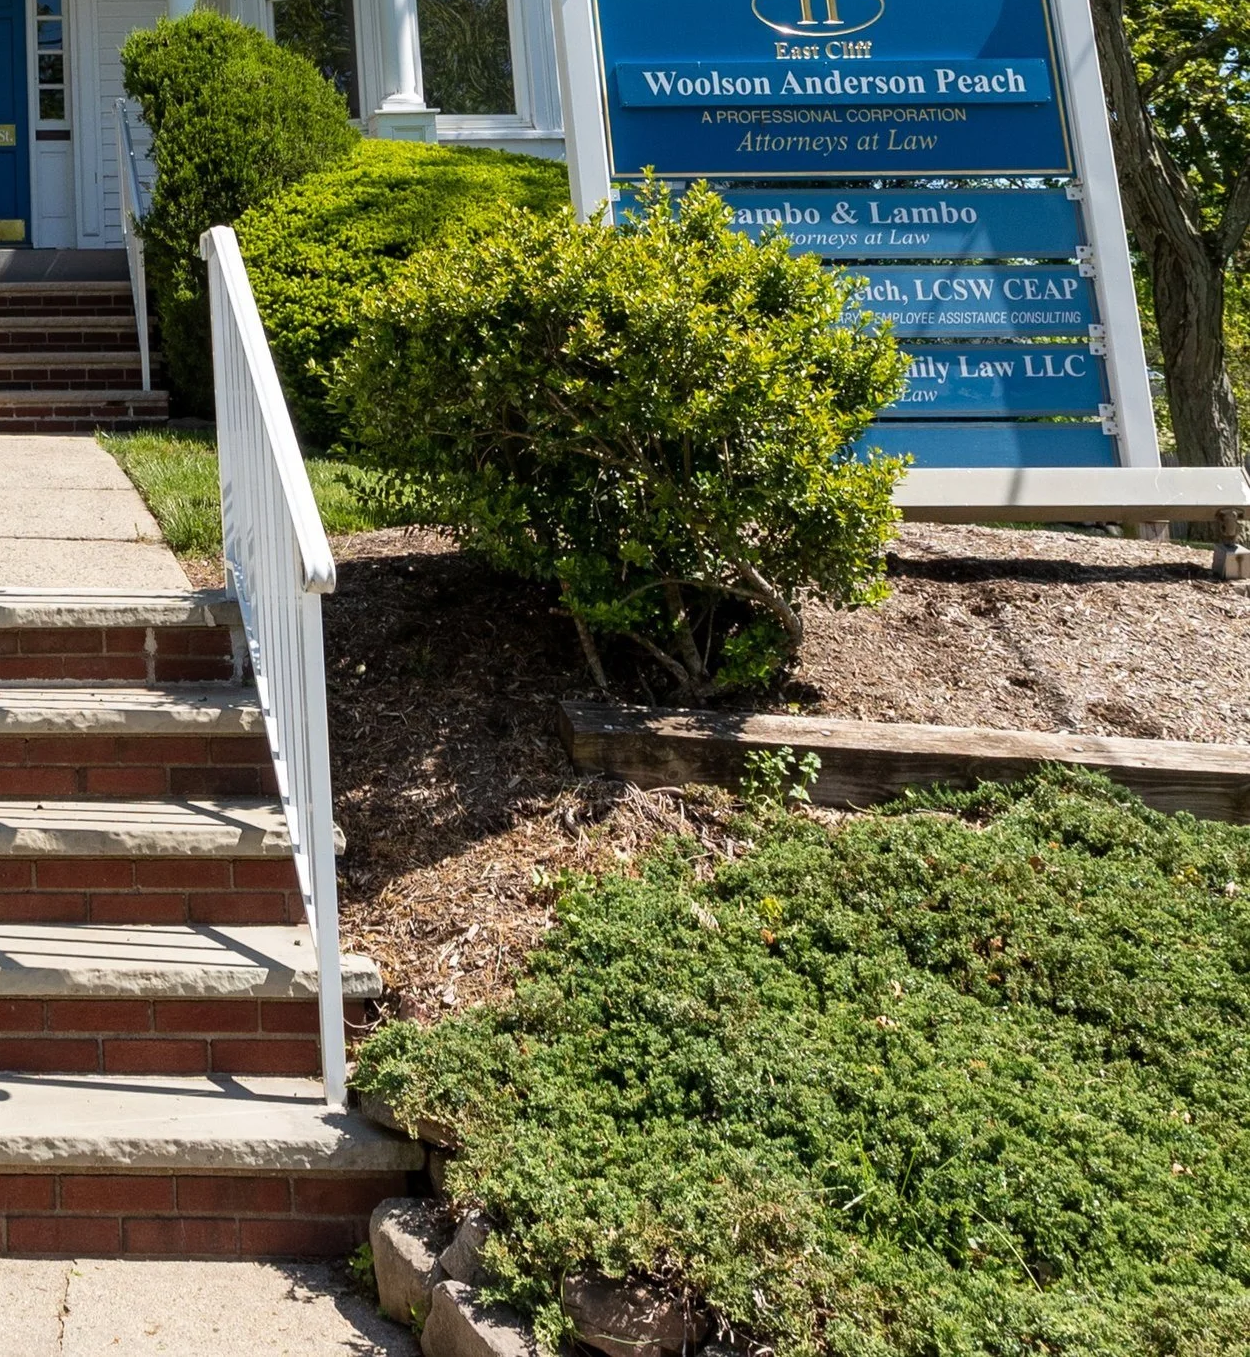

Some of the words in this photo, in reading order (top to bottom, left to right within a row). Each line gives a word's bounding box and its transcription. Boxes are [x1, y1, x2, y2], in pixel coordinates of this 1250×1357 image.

[774, 42, 820, 60] East
[825, 40, 873, 59] Cliff
[642, 70, 772, 96] Woolson
[779, 69, 926, 95] Anderson
[934, 68, 1027, 94] Peach
[701, 111, 713, 124] A
[717, 110, 842, 123] PROFESSIONAL
[846, 108, 967, 122] CORPORATION
[736, 130, 848, 156] Attorneys
[857, 132, 880, 151] at
[887, 129, 938, 151] Law
[729, 202, 820, 224] ambo
[831, 201, 859, 224] &
[868, 201, 977, 224] Lambo
[864, 231, 882, 245] at
[889, 229, 930, 245] Law
[848, 280, 908, 305] eich,
[913, 279, 995, 301] LCSW
[1003, 278, 1078, 301] CEAP
[874, 312, 934, 324] EMPLOYEE
[938, 312, 1007, 324] ASSISTANCE
[1011, 311, 1082, 324] CONSULTING
[958, 355, 1015, 378] Law
[1022, 354, 1087, 378] LLC
[900, 388, 938, 402] Law
